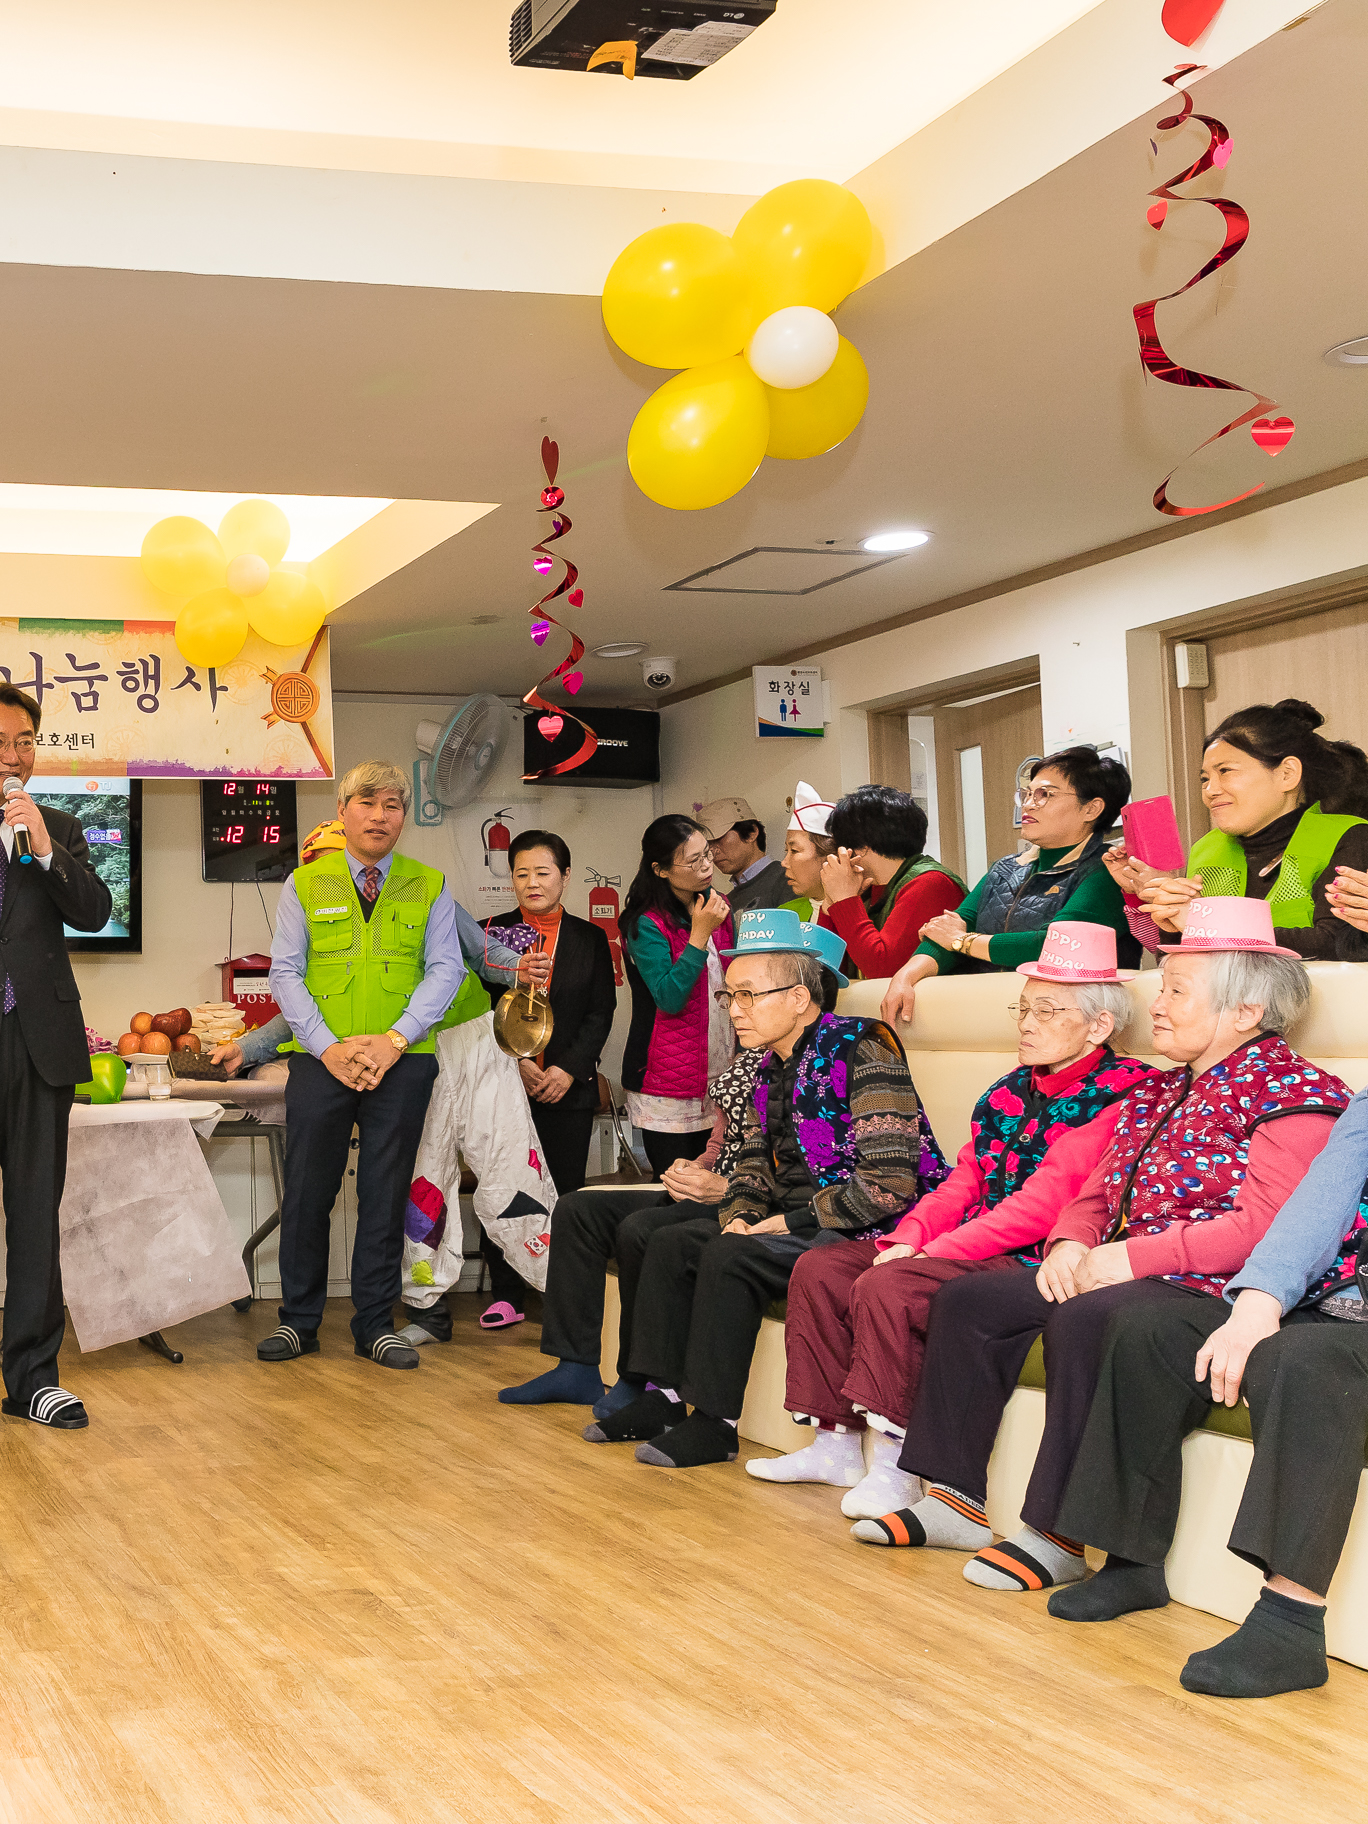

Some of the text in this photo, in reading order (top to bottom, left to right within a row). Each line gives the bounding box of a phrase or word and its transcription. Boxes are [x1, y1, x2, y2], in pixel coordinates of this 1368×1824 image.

[768, 680, 811, 696] 화장실
[226, 825, 281, 844] 12 15
[741, 912, 766, 923] PPY
[1190, 901, 1213, 918] PPY
[739, 929, 775, 940] THDAY
[1042, 950, 1085, 970] THDAY
[236, 994, 276, 1004] POST
